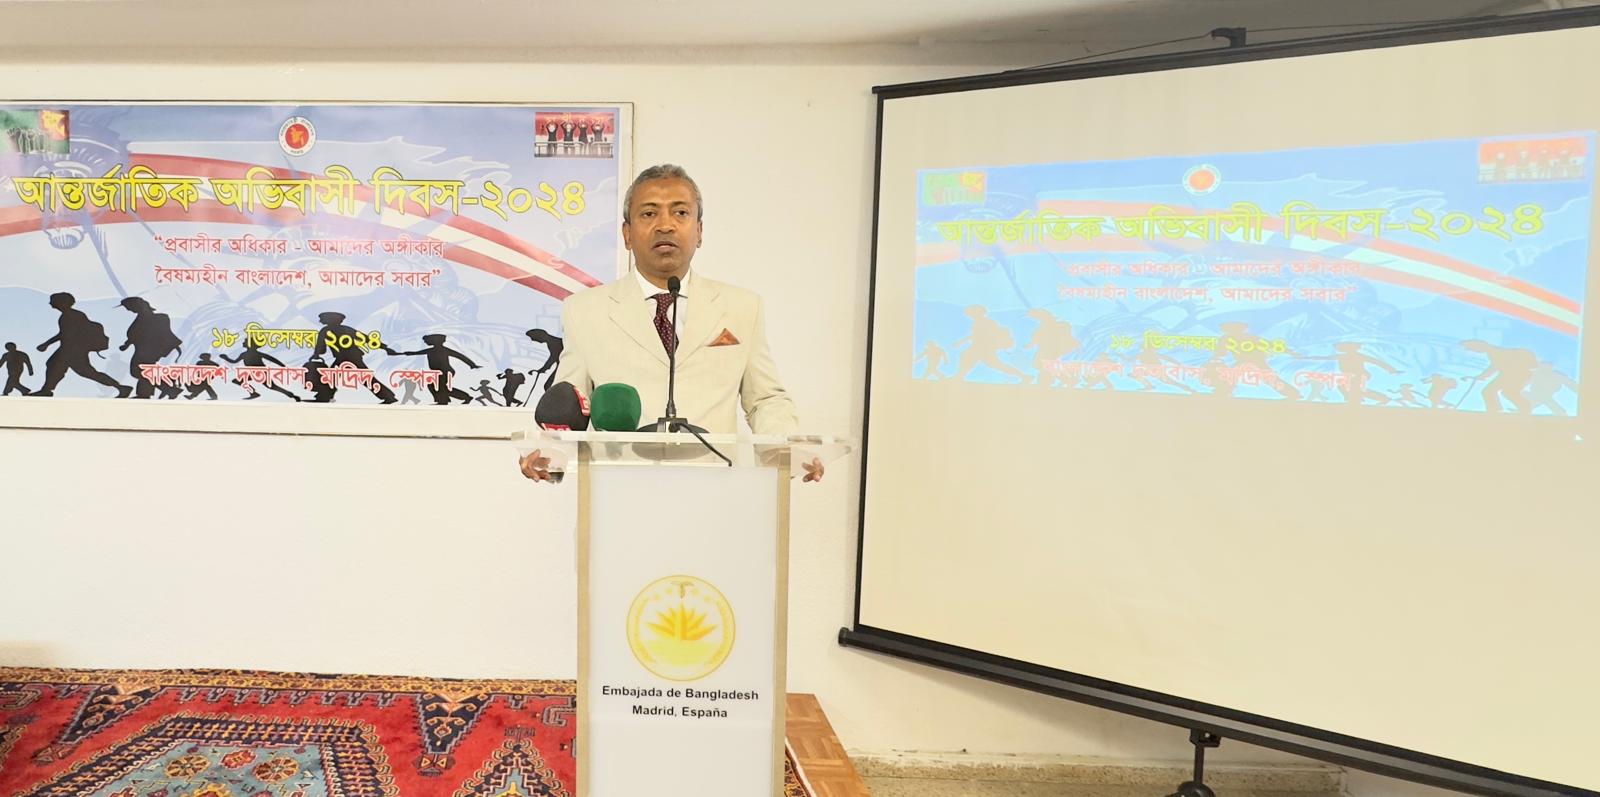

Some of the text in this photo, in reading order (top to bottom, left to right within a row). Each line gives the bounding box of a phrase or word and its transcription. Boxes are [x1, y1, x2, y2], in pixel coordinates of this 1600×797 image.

[11, 163, 586, 222] আন্তর্জাতিক অভিবাসী দিবস-২০২৪
[937, 200, 1544, 245] আন্তর্জাতিক অভিবাসী দিবস-২০২৪
[154, 233, 222, 255] “প্রবাসীর
[228, 234, 287, 255] অধিকার
[307, 239, 374, 256] আমাদের
[380, 233, 445, 257] অঙ্গীকার
[154, 264, 441, 289] বৈষম্যহীন বাংলাদেশ, আমাদের সবার”
[212, 322, 383, 353] ১৮ ডিসেম্বর ২০২৪
[1224, 336, 1288, 354] ২০২৪
[139, 363, 228, 387] বাংলাদেশ
[235, 363, 314, 392] দূতাবাস,
[318, 361, 382, 393] মাদ্রিদ,
[389, 367, 443, 392] স্পেন
[602, 685, 759, 701] Embajada de Bangladesh
[632, 705, 728, 719] Madrid, España
